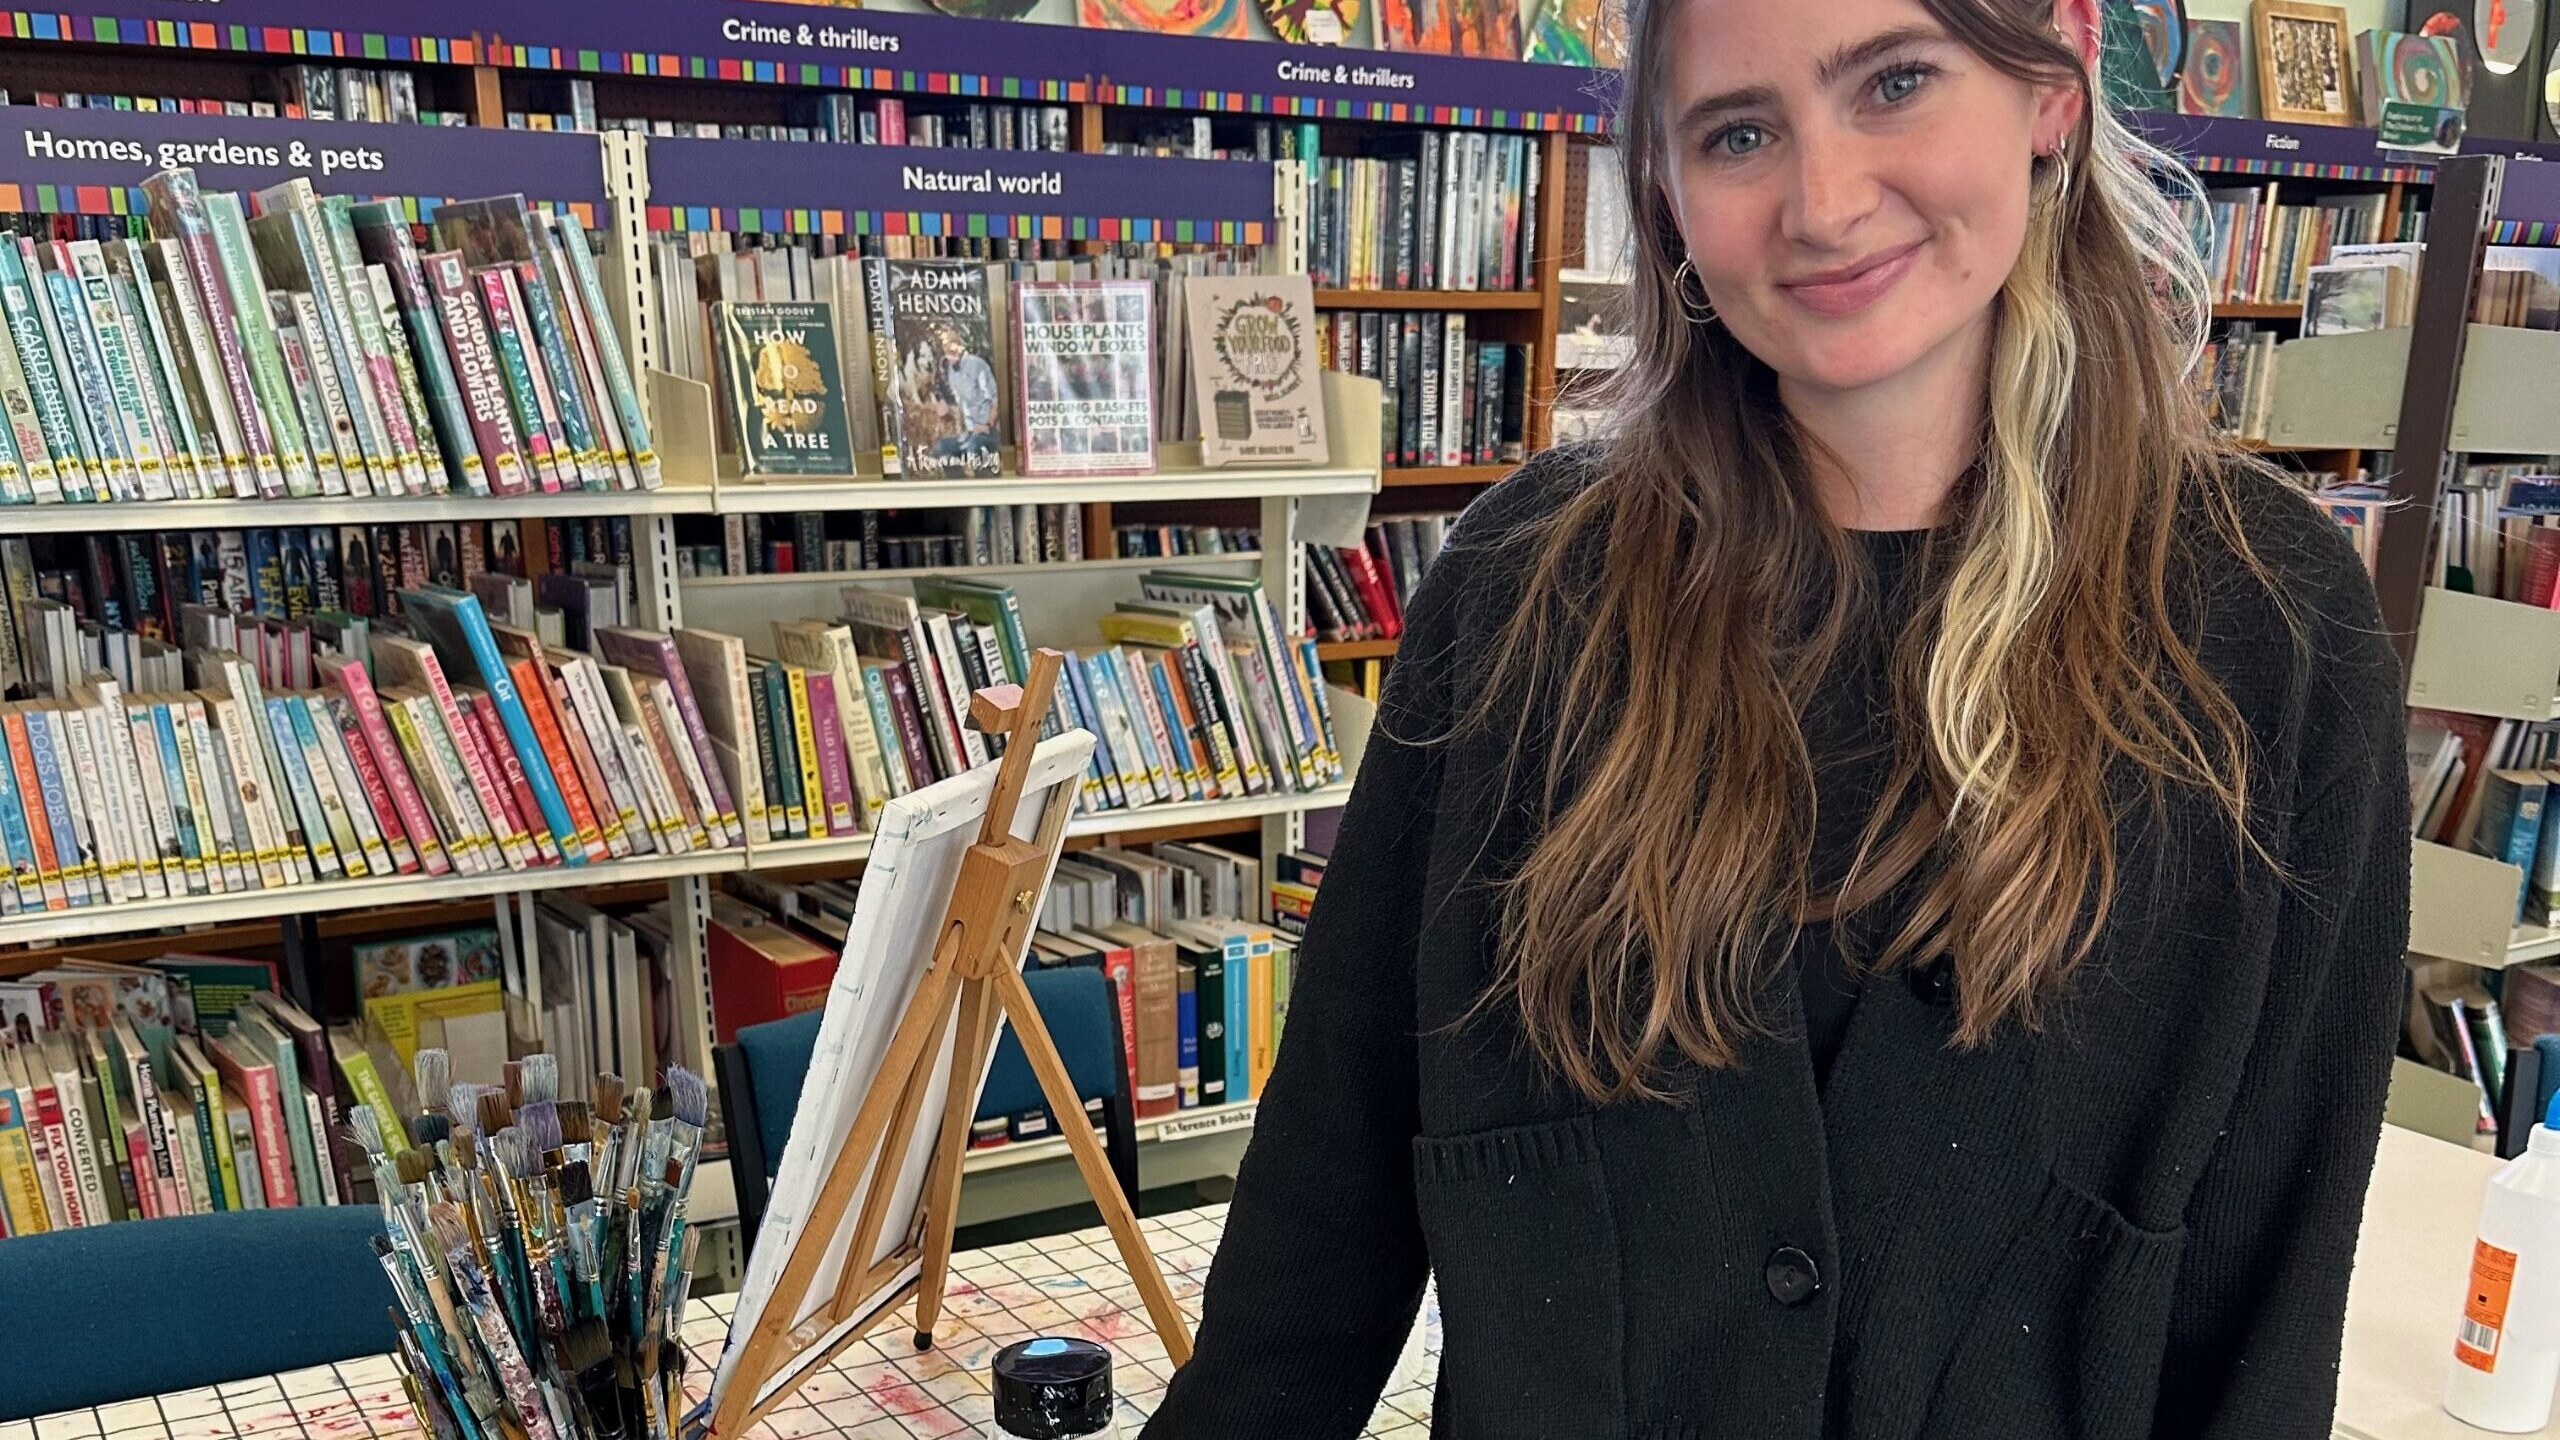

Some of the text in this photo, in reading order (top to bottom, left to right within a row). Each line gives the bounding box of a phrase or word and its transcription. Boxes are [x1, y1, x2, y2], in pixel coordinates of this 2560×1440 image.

[722, 19, 900, 54] Crime & thrillers
[1277, 61, 1415, 91] Crime & thrillers
[25, 129, 385, 176] Homes, gardens & pets
[2265, 134, 2301, 150] Fiction
[903, 165, 1062, 195] Natural world
[910, 269, 968, 290] ADAM
[168, 250, 210, 352] The Jewel Garden
[340, 262, 390, 360] Herbs
[898, 292, 983, 315] HENSON
[97, 326, 111, 339] IN
[754, 328, 806, 345] HOW
[868, 267, 889, 382] ADAM HENSON
[1024, 323, 1146, 340] HOUSEPLANTS
[298, 297, 347, 417] MONTY DON
[441, 291, 495, 424] AND FLOWERS
[1025, 340, 1147, 353] WINDOW BOXES
[18, 312, 78, 447] GARDENING
[103, 347, 125, 385] SQUARE
[108, 324, 153, 438] GROW ALL YOU CAN EAT
[457, 289, 496, 371] GARDEN
[481, 372, 517, 445] PLANTS
[114, 384, 133, 413] FEET
[1421, 369, 1438, 415] STORM
[1029, 414, 1059, 427] POTS
[784, 433, 830, 450] TREE
[473, 546, 484, 572] JAM
[982, 637, 1003, 675] BILL
[492, 677, 514, 704] Cat
[746, 676, 771, 727] PLANTA
[1189, 647, 1208, 683] Raising
[1200, 681, 1220, 722] Chickens
[222, 708, 240, 736] Until
[866, 670, 895, 739] OUR ZOO
[68, 717, 95, 764] Haatchi
[354, 682, 382, 723] TOP
[374, 727, 402, 772] DOG
[418, 699, 445, 740] LOST
[435, 735, 462, 776] DOG
[818, 717, 836, 748] WILD
[177, 735, 198, 774] Arthur
[229, 736, 252, 779] Tuesday
[503, 754, 526, 786] Cat
[754, 727, 779, 778] SAPIENS
[26, 717, 71, 829] DOGS JOBS
[480, 787, 501, 820] DOGS
[137, 1062, 169, 1151] Home Plumbing
[323, 1095, 341, 1126] WALL
[48, 1126, 65, 1150] FIX
[65, 1106, 100, 1194] CONVERTED
[54, 1150, 75, 1190] YOUR
